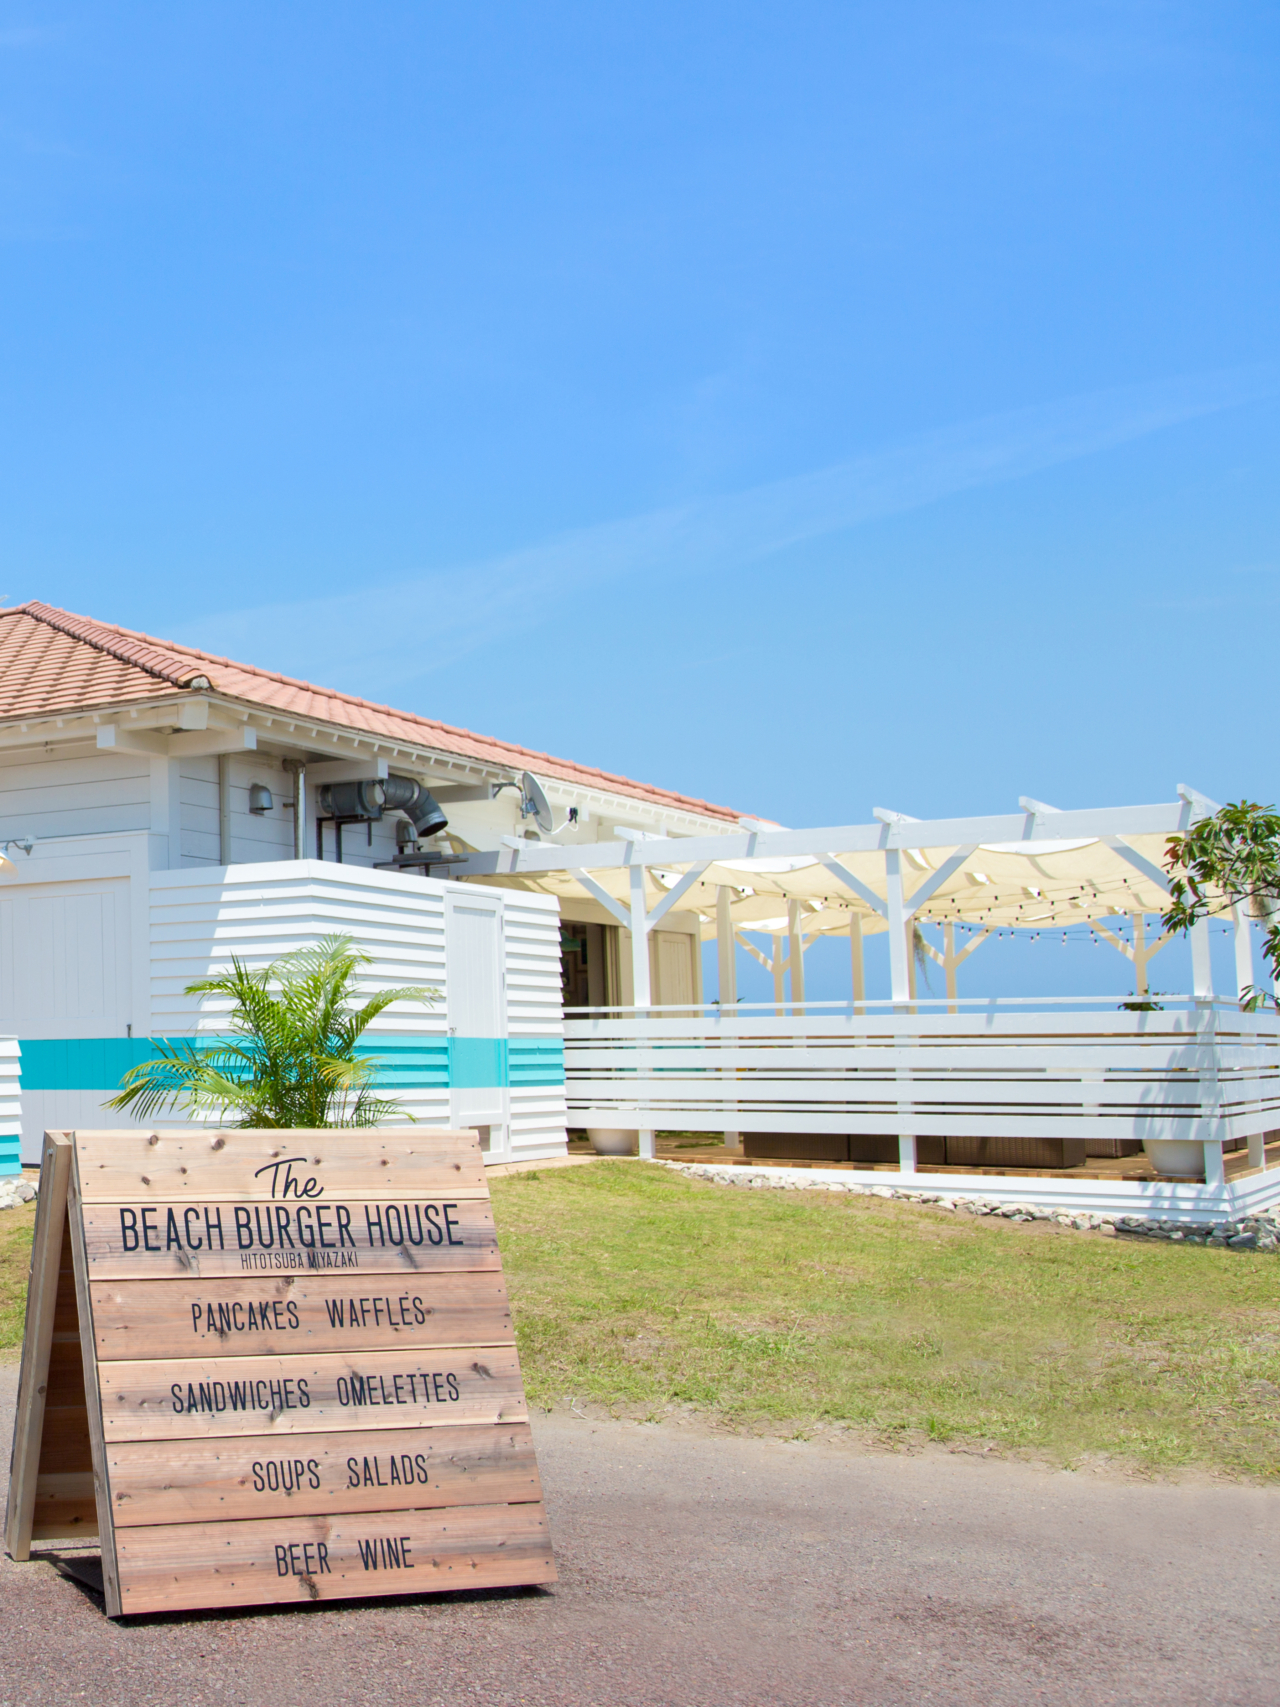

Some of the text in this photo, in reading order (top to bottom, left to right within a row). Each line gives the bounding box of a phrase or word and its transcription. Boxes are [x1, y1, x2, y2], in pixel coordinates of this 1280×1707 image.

[254, 1157, 324, 1199] The
[120, 1203, 464, 1252] BEACH BURGER HOUSE
[240, 1251, 359, 1270] HITOTSUBA MIYAZAKI
[191, 1296, 426, 1333] PANCAKES WAFFLES
[170, 1373, 460, 1414] SANDWICHES OMELETTES
[252, 1454, 429, 1492] SOUPS SALADS
[275, 1537, 415, 1577] BEER WINE
